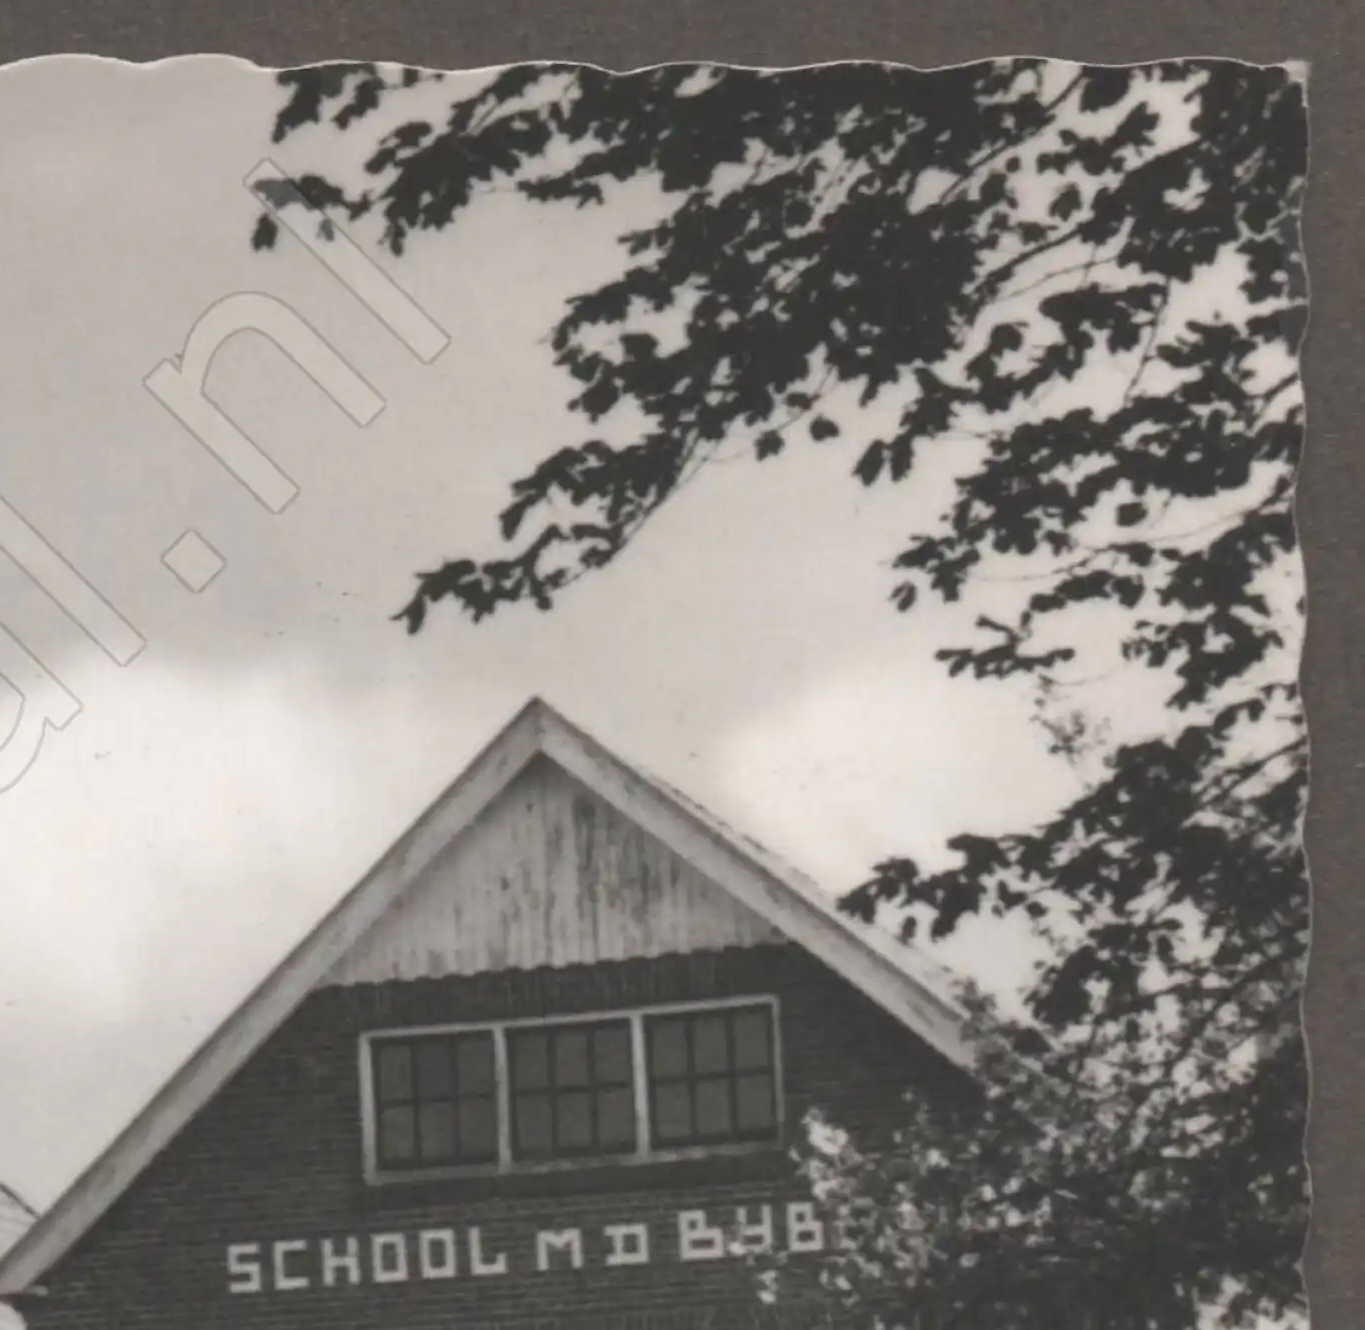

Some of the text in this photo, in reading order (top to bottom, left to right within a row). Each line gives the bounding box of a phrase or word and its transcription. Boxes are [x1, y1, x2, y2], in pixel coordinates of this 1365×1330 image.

[226, 1201, 824, 1293] SCHOOL M D BYB
